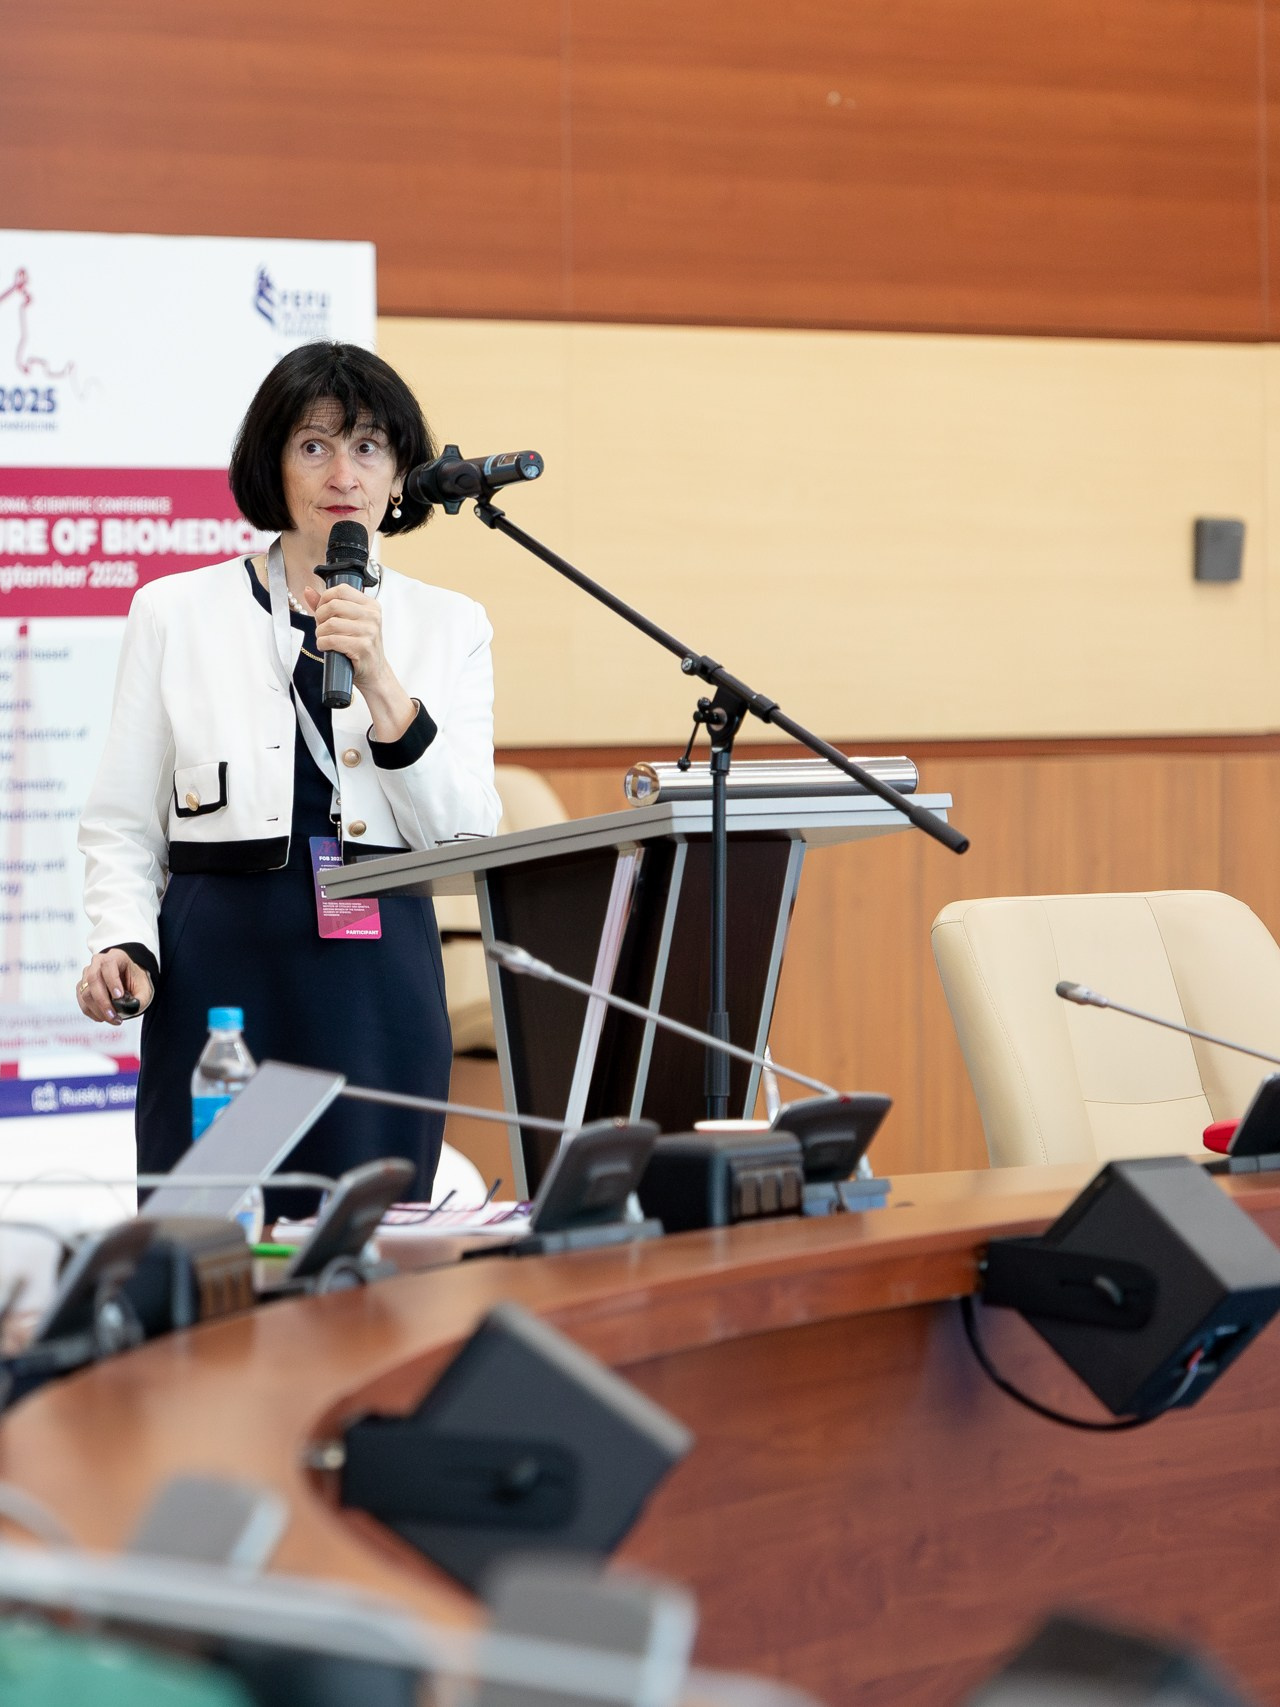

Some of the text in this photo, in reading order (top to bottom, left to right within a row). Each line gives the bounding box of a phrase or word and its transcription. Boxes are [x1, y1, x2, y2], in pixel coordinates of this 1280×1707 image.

[94, 497, 172, 515] CONFERENCE
[52, 518, 98, 556] OF
[102, 518, 270, 556] BIOMEDIC
[88, 560, 138, 588] 2025
